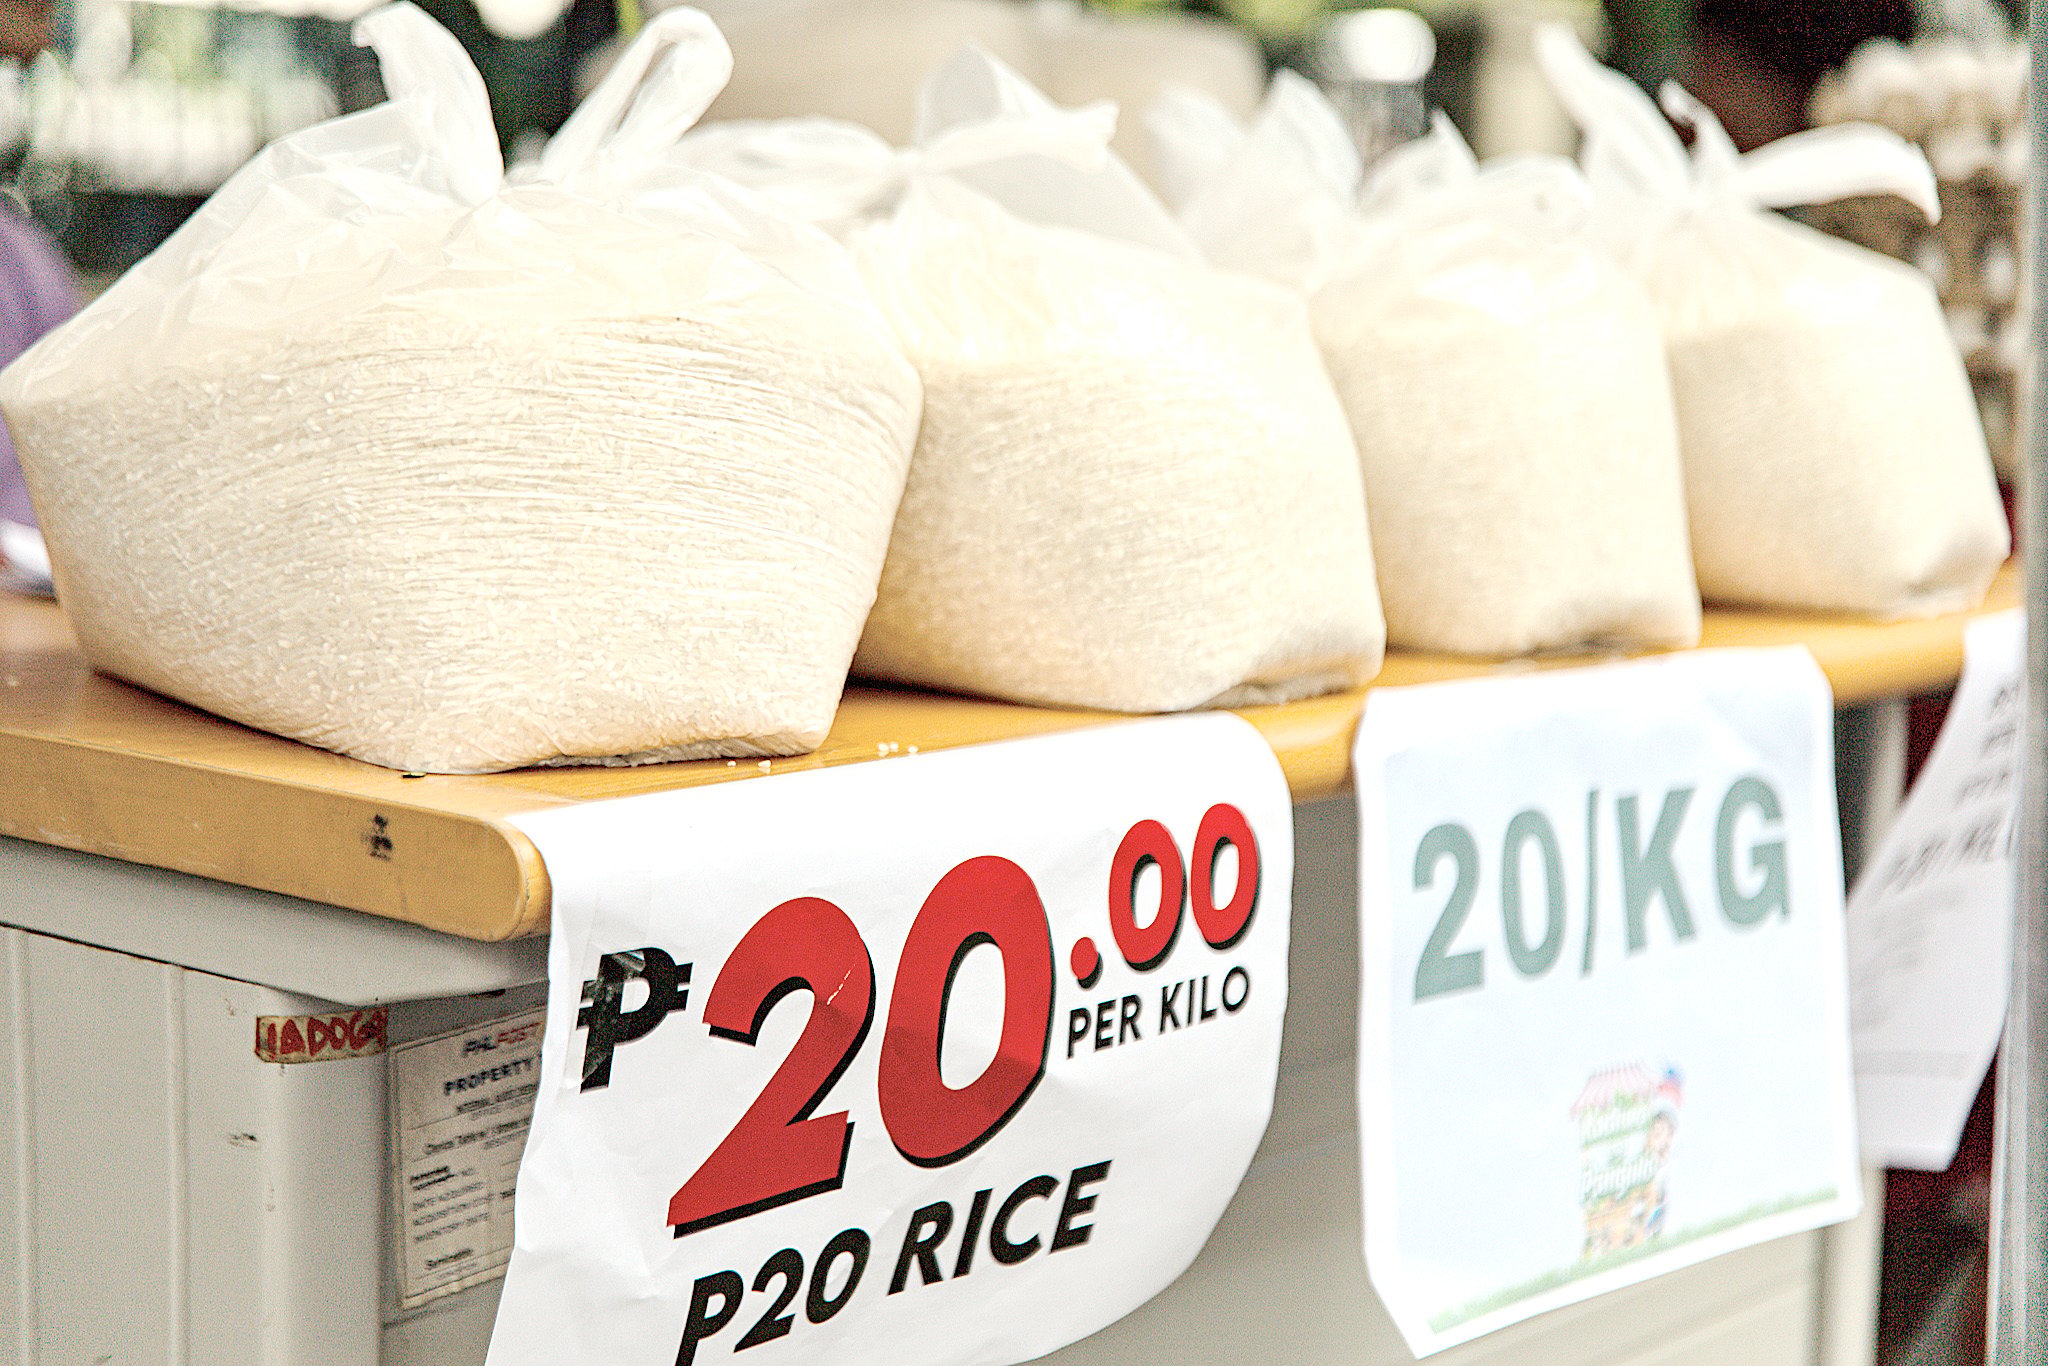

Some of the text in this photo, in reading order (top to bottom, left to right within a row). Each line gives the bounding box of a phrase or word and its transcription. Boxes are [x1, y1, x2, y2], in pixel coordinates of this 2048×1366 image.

[1412, 776, 1791, 1004] 20/KG
[443, 1060, 533, 1096] PROPERTY
[1067, 964, 1251, 1059] PER KILO
[674, 1160, 1113, 1366] P20 RICE
